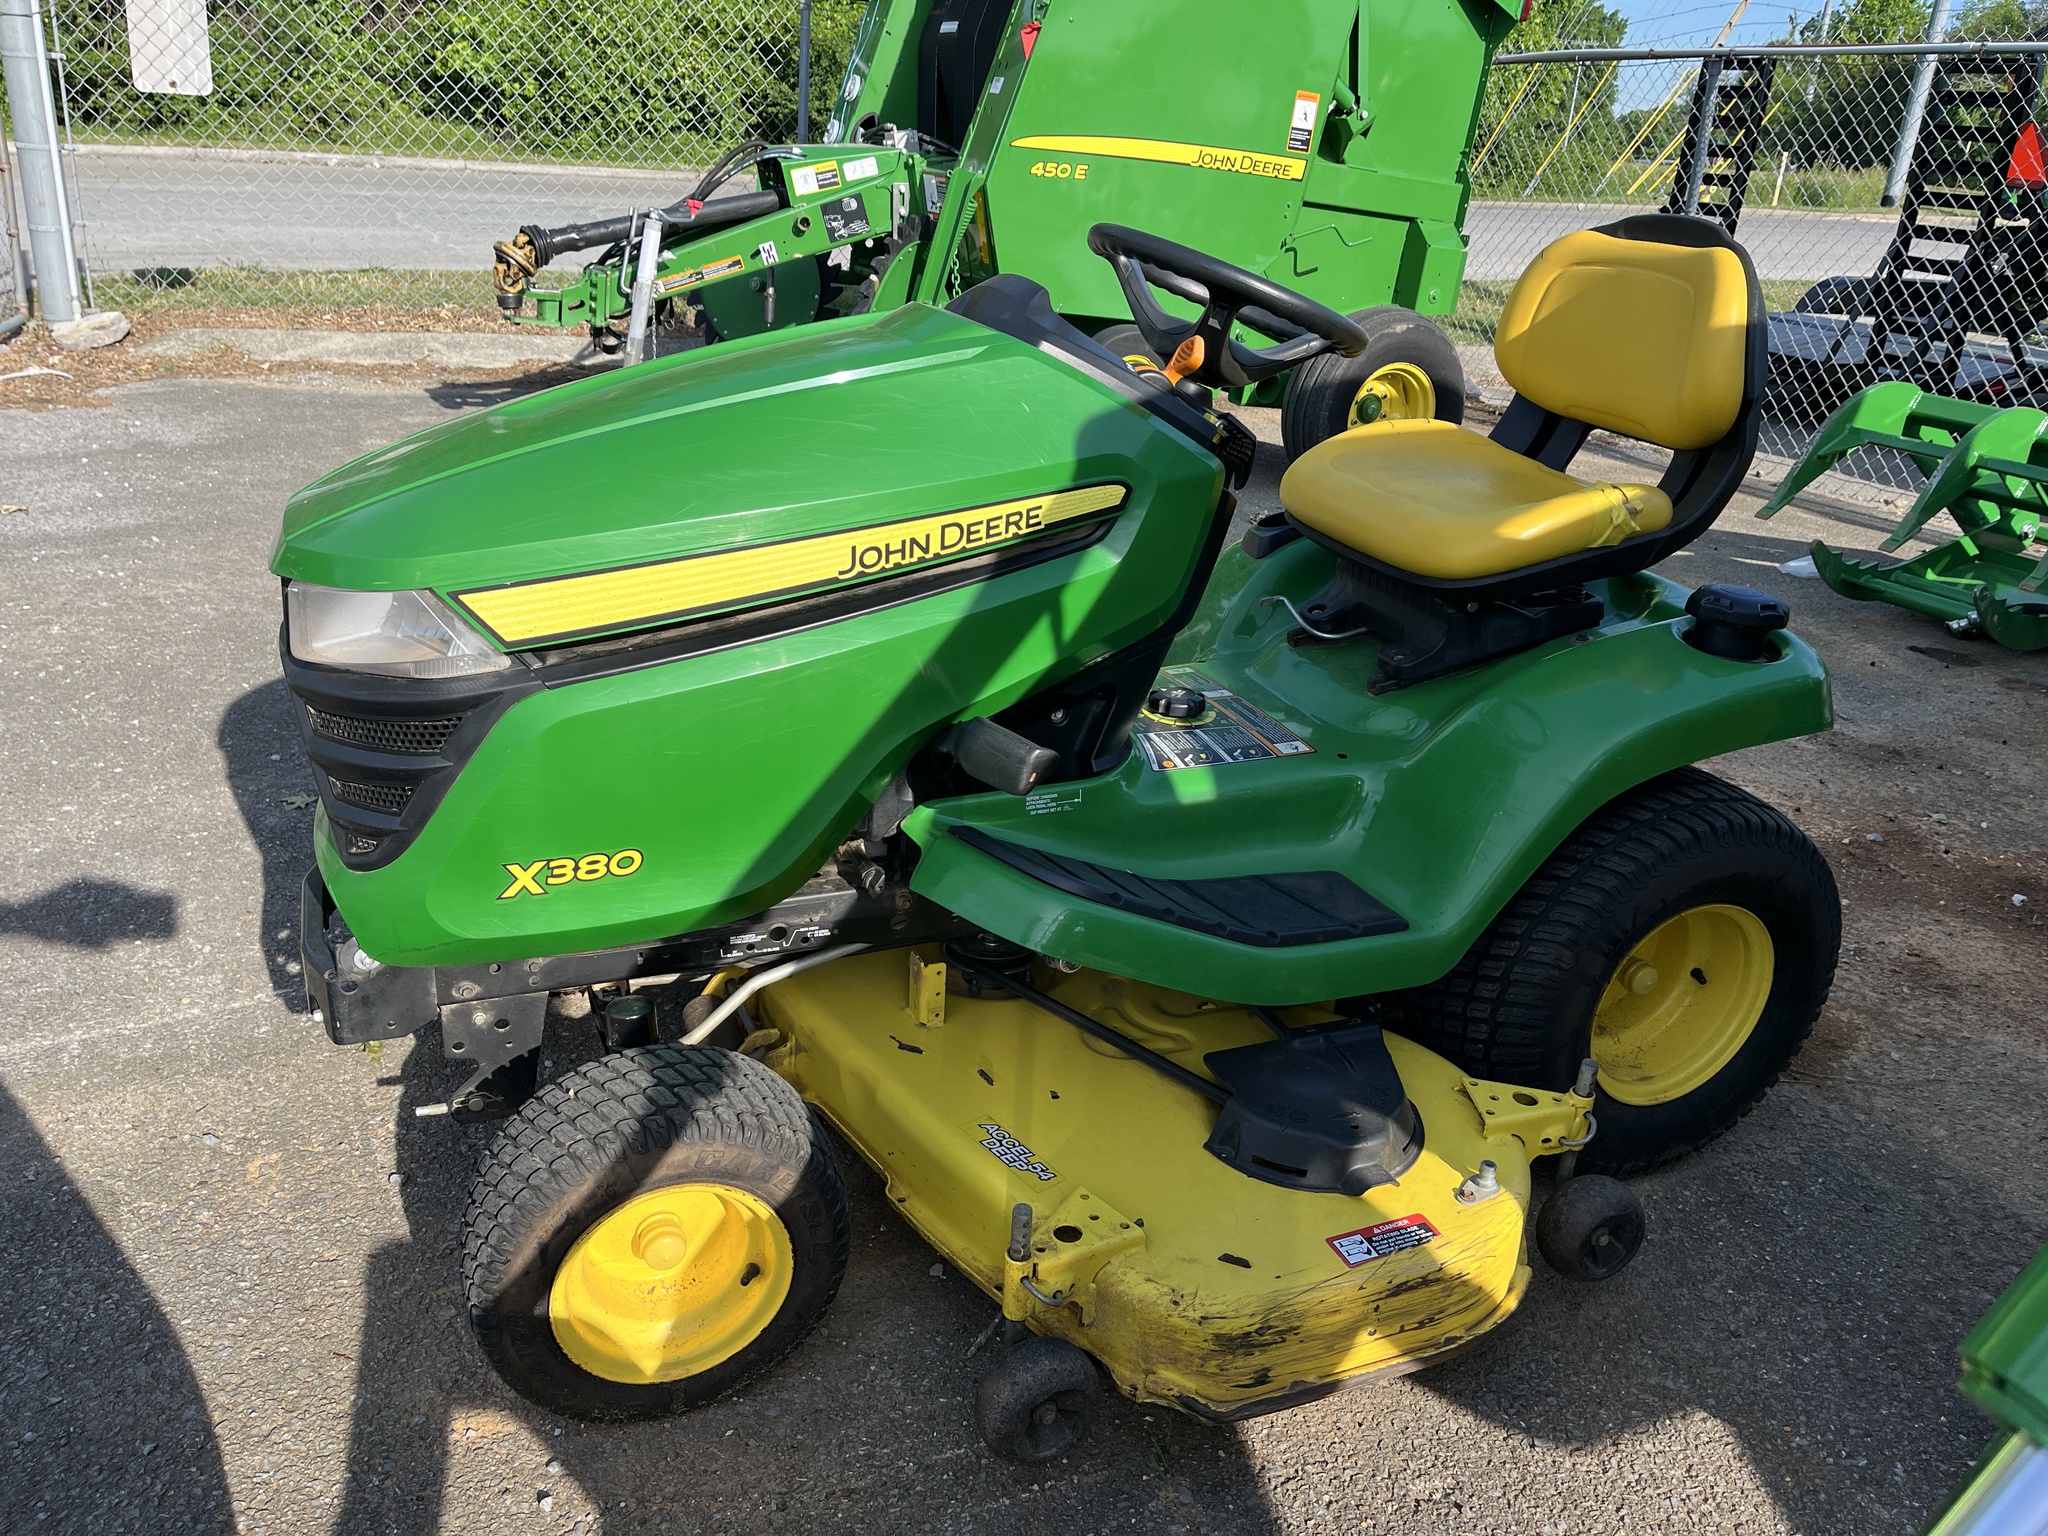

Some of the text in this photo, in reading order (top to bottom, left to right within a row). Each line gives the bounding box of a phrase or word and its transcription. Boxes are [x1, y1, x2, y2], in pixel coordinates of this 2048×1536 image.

[1029, 161, 1090, 180] 450 E
[1192, 149, 1293, 177] JOHN DEERE
[838, 504, 1043, 576] JOHN DEERE
[495, 848, 644, 900] X380
[977, 1123, 1057, 1182] ACCEL 54
[979, 1138, 1030, 1172] DEEP
[1372, 1225, 1420, 1242] ROTATING BLADE
[1379, 1219, 1410, 1231] DANGER
